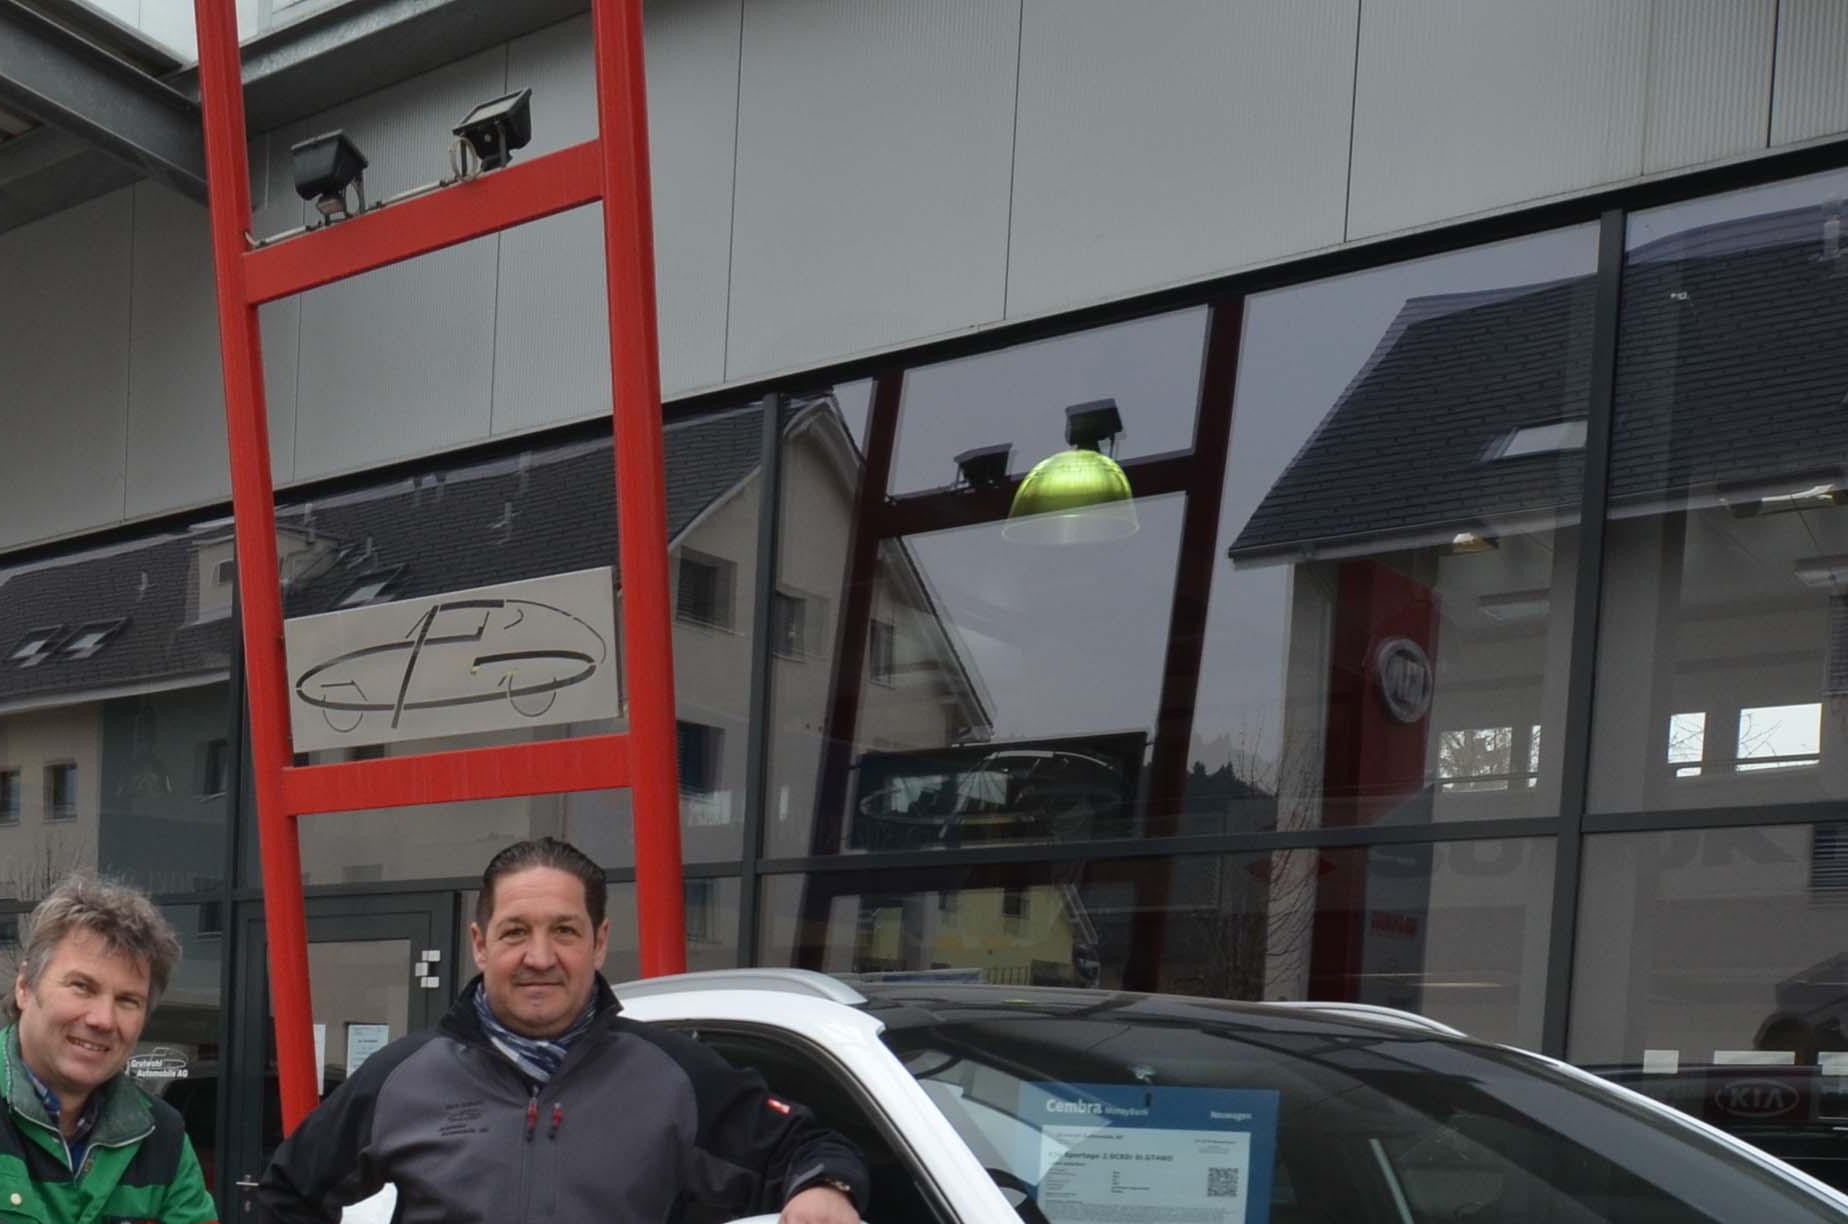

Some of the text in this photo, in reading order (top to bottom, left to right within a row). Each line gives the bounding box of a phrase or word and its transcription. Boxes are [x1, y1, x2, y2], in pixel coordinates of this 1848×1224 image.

[136, 1069, 189, 1078] Automobile AG
[1046, 1098, 1102, 1115] Cembra
[1729, 1087, 1785, 1109] KIA
